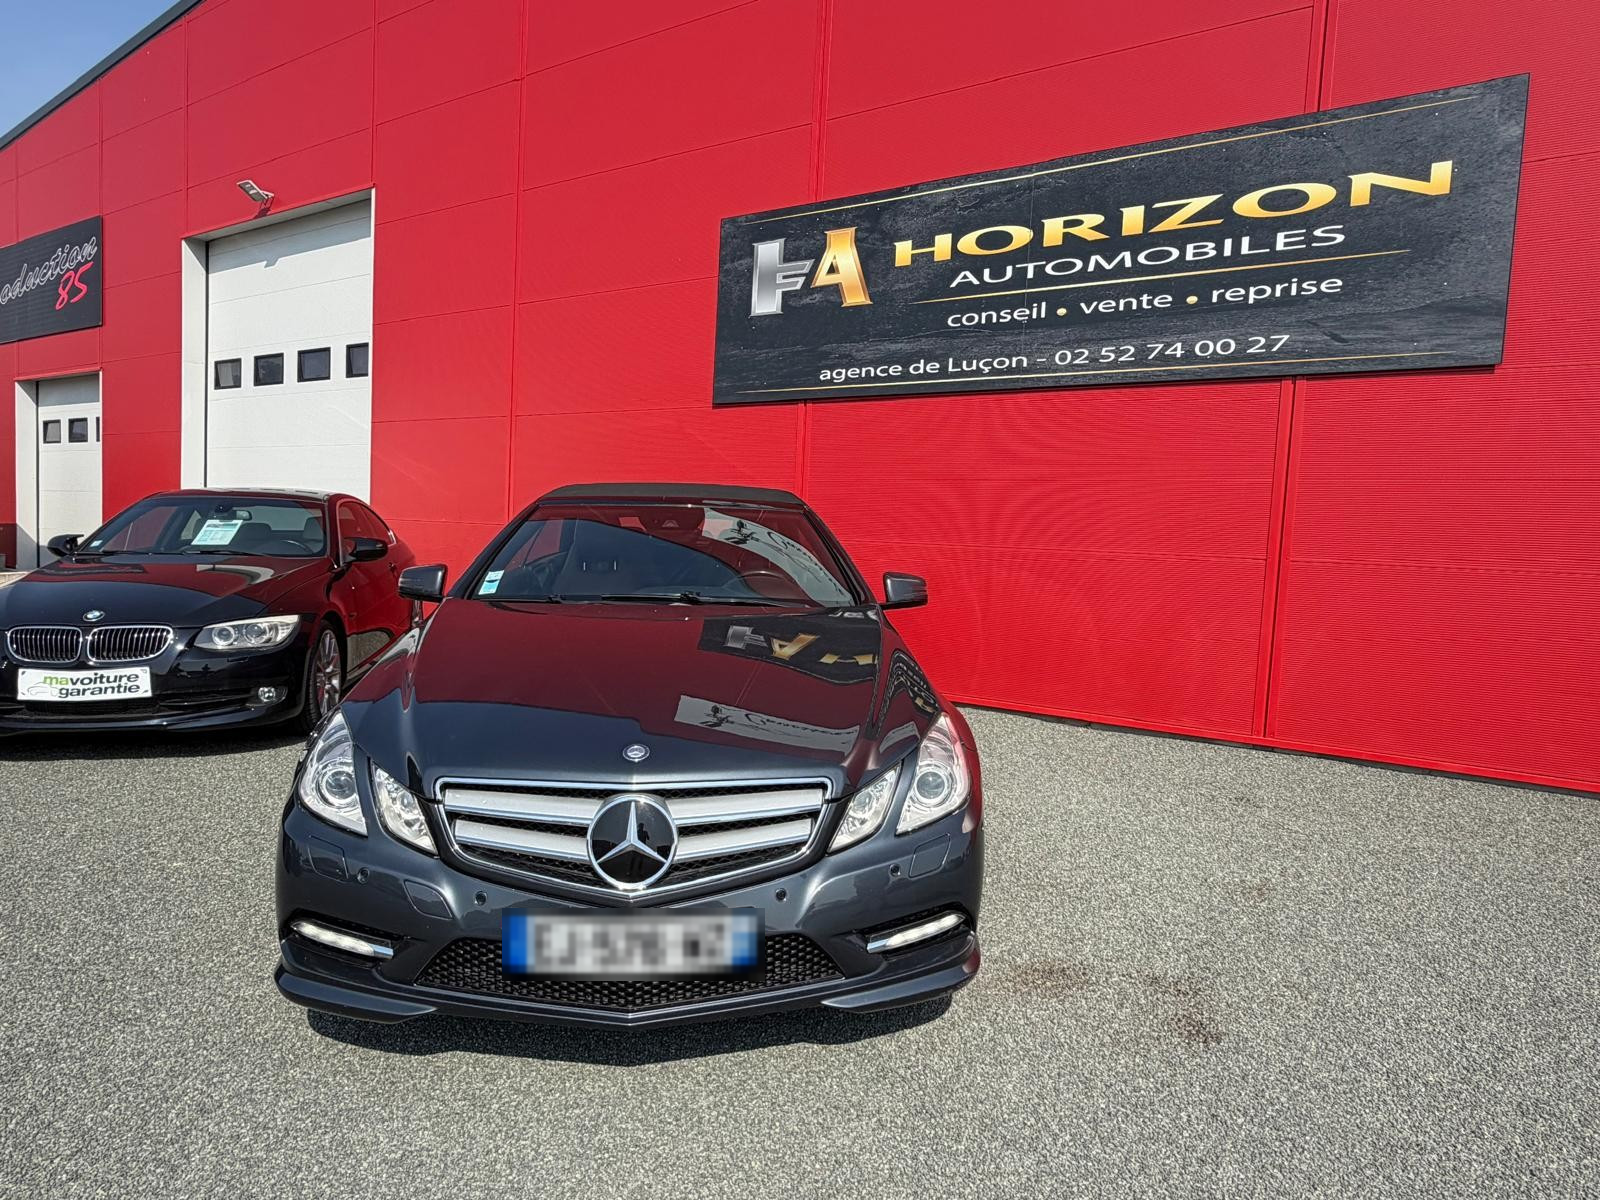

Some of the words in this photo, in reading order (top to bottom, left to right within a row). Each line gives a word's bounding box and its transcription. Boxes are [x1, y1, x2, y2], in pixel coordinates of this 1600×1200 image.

[893, 160, 1452, 267] HORIZON
[949, 224, 1346, 288] AUTOMOBILES
[55, 261, 94, 310] 85
[946, 301, 1047, 328] conseil
[1079, 293, 1173, 315] vente
[1211, 277, 1343, 308] reprise
[819, 361, 903, 382] agence
[908, 357, 940, 374] de
[947, 352, 1028, 375] Luçon
[1054, 348, 1089, 365] 02
[1098, 345, 1136, 362] 52
[1146, 341, 1186, 360] 74
[1194, 338, 1237, 358] 00
[1246, 335, 1290, 353] 27
[43, 673, 139, 686] mavoiture
[58, 683, 140, 698] garantie
